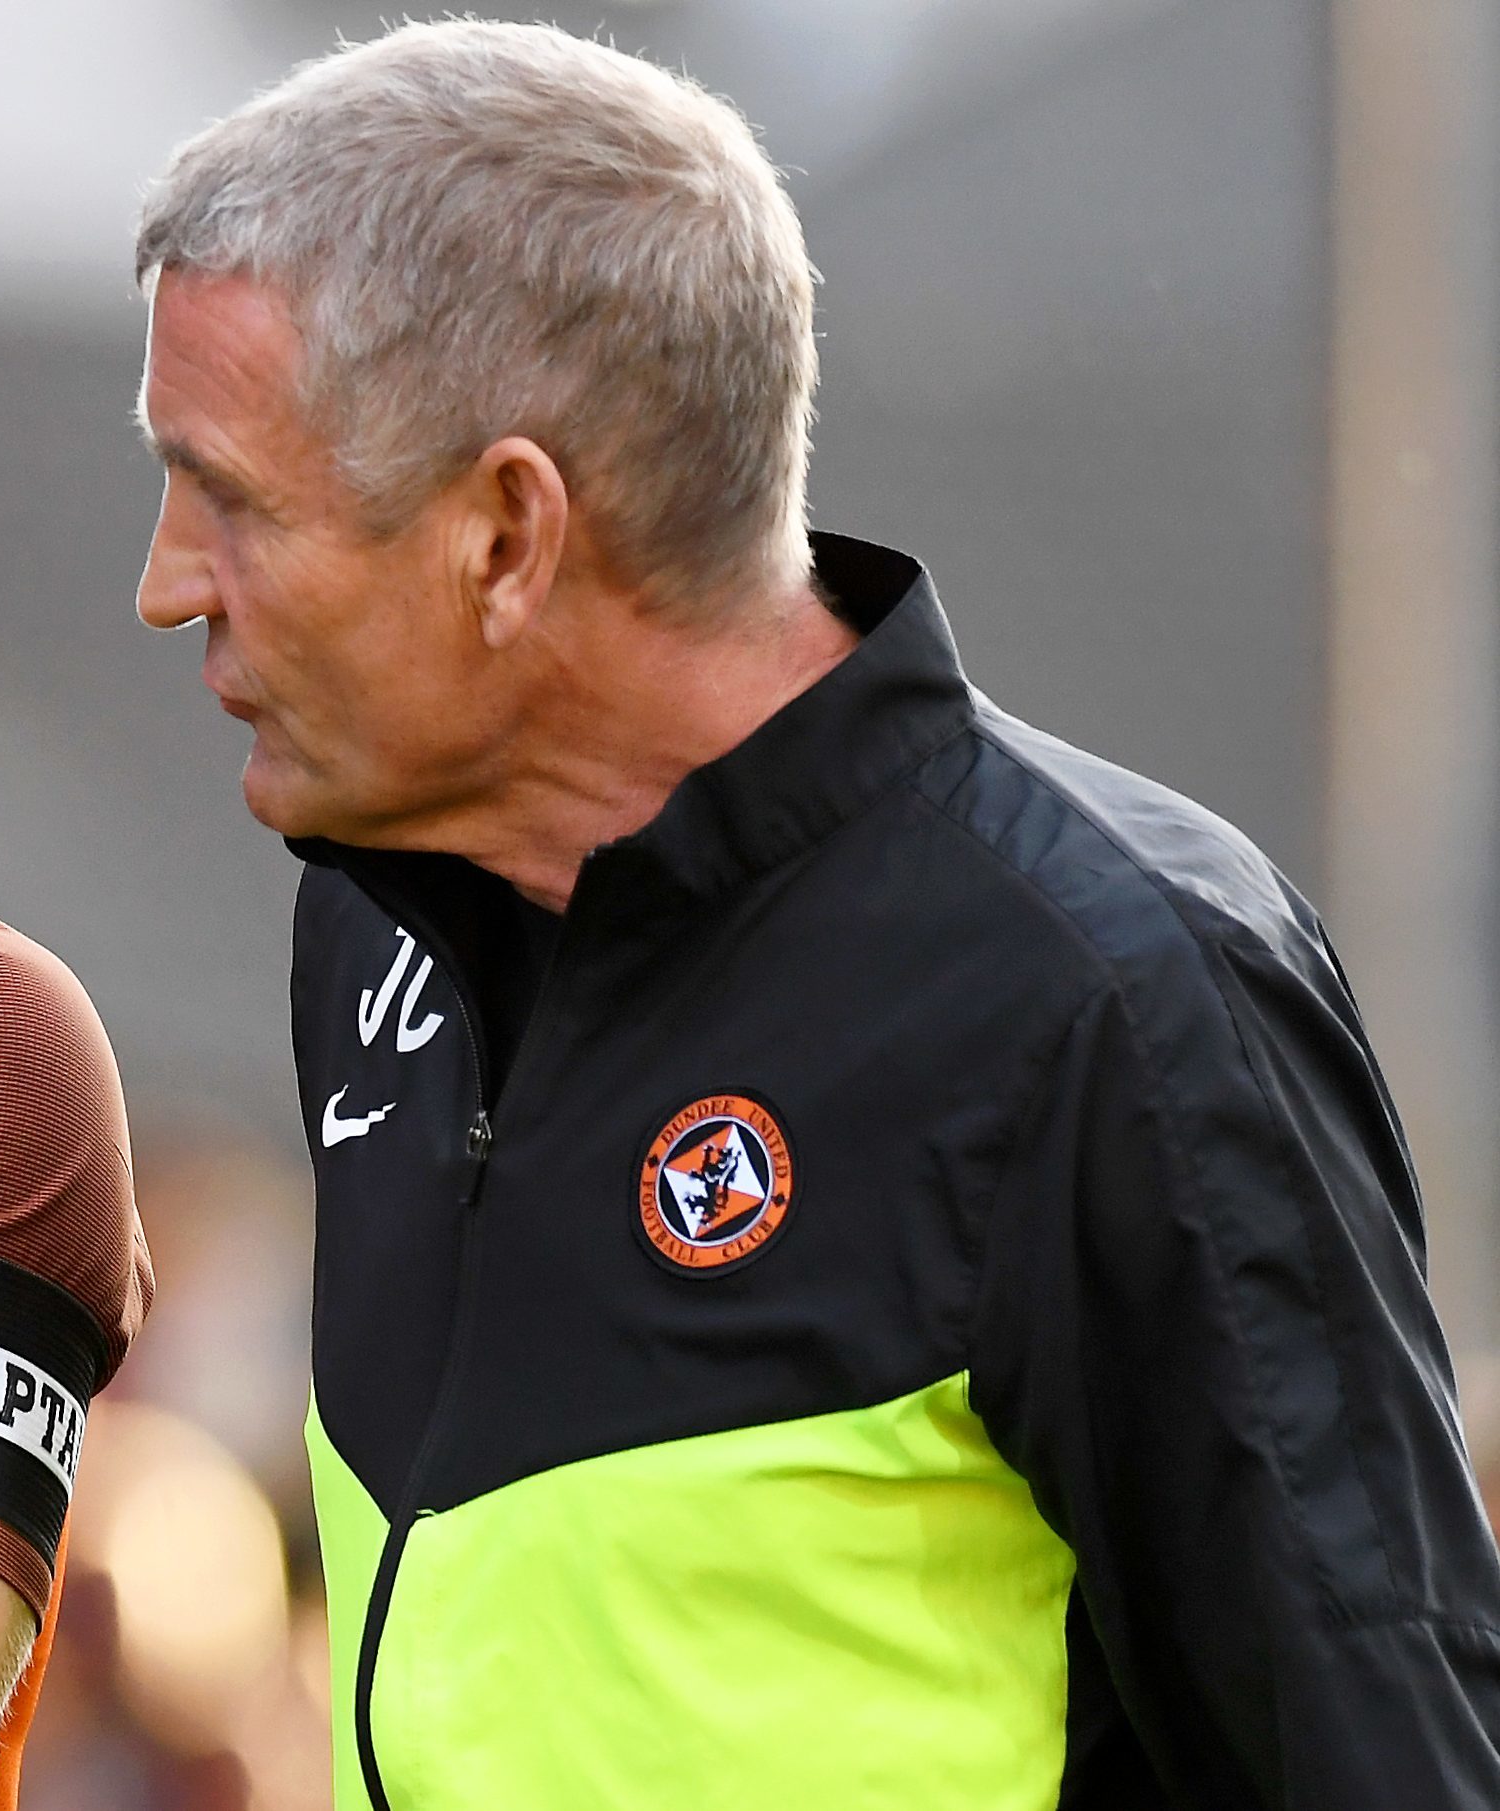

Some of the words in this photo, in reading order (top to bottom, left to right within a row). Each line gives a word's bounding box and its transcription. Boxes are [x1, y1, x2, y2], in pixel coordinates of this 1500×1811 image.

[660, 1099, 736, 1145] DUNDEE
[748, 1108, 788, 1179] UNITED
[641, 1180, 700, 1263] FOOTBALL
[721, 1219, 774, 1259] CLUB
